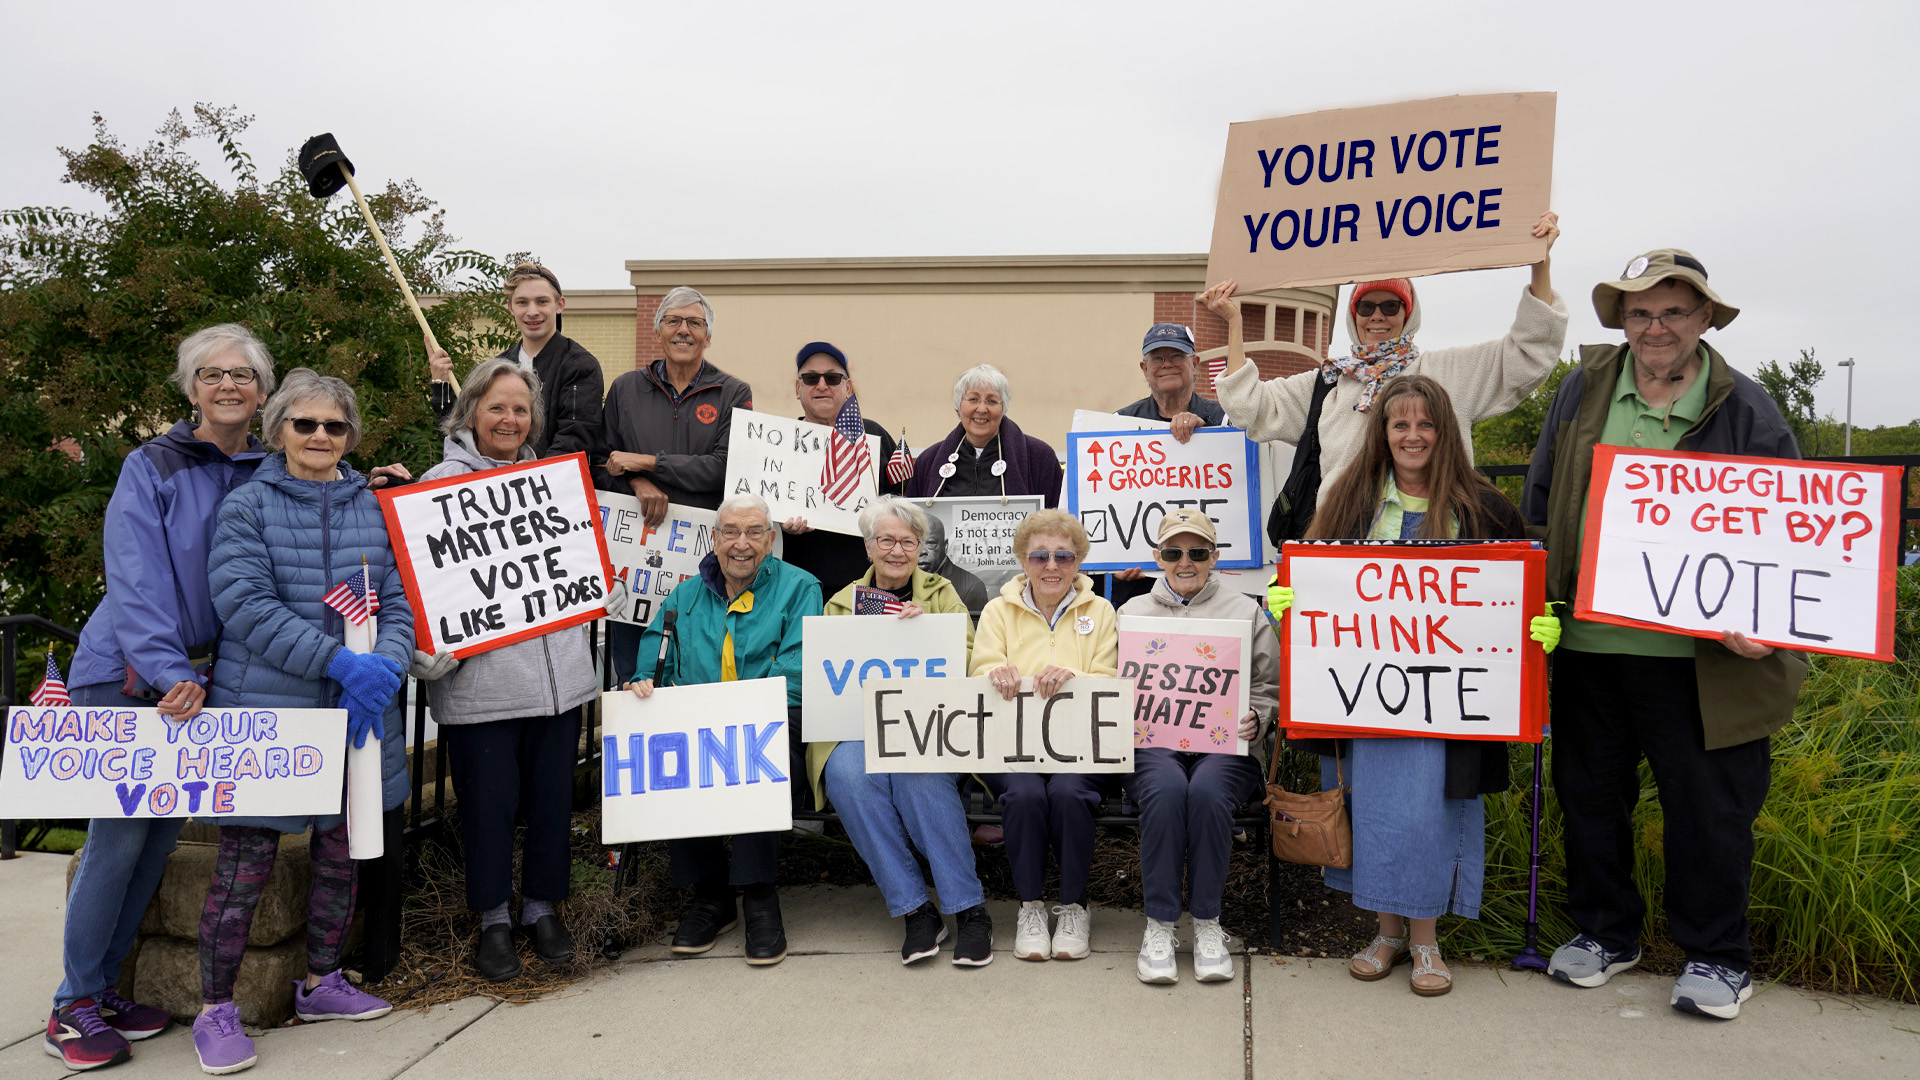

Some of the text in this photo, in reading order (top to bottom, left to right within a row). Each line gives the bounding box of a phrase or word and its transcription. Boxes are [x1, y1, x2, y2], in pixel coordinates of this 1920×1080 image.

[1257, 124, 1502, 188] YOUR VOTE
[1243, 188, 1503, 253] YOUR VOICE
[748, 421, 783, 446] NO
[763, 456, 783, 473] IN
[1109, 440, 1167, 467] GAS
[1108, 463, 1233, 491] GROCERIES
[1625, 462, 1867, 506] STRUGGLING
[432, 474, 552, 526] TRUTH
[961, 510, 1028, 522] Democracy
[426, 506, 593, 568] MATTERS...
[955, 527, 1016, 538] is not a sta
[1631, 498, 1873, 562] TO GET BY?
[962, 543, 970, 555] It
[975, 543, 983, 555] is
[987, 546, 1001, 555] an
[977, 558, 1017, 567] John Lewis
[470, 546, 567, 600] VOTE
[440, 604, 505, 644] LIKE
[522, 590, 547, 623] IT
[553, 575, 603, 611] DOES
[1641, 551, 1834, 643] VOTE
[1121, 661, 1239, 696] RESIST
[1328, 662, 1490, 724] VOTE
[10, 709, 278, 745] MAKE YOUR
[875, 689, 1127, 764] Evict I.C.E.
[1134, 694, 1212, 729] HATE
[19, 745, 323, 781] VOICE HEARD
[603, 721, 788, 798] HONK
[116, 782, 235, 816] VOTE
